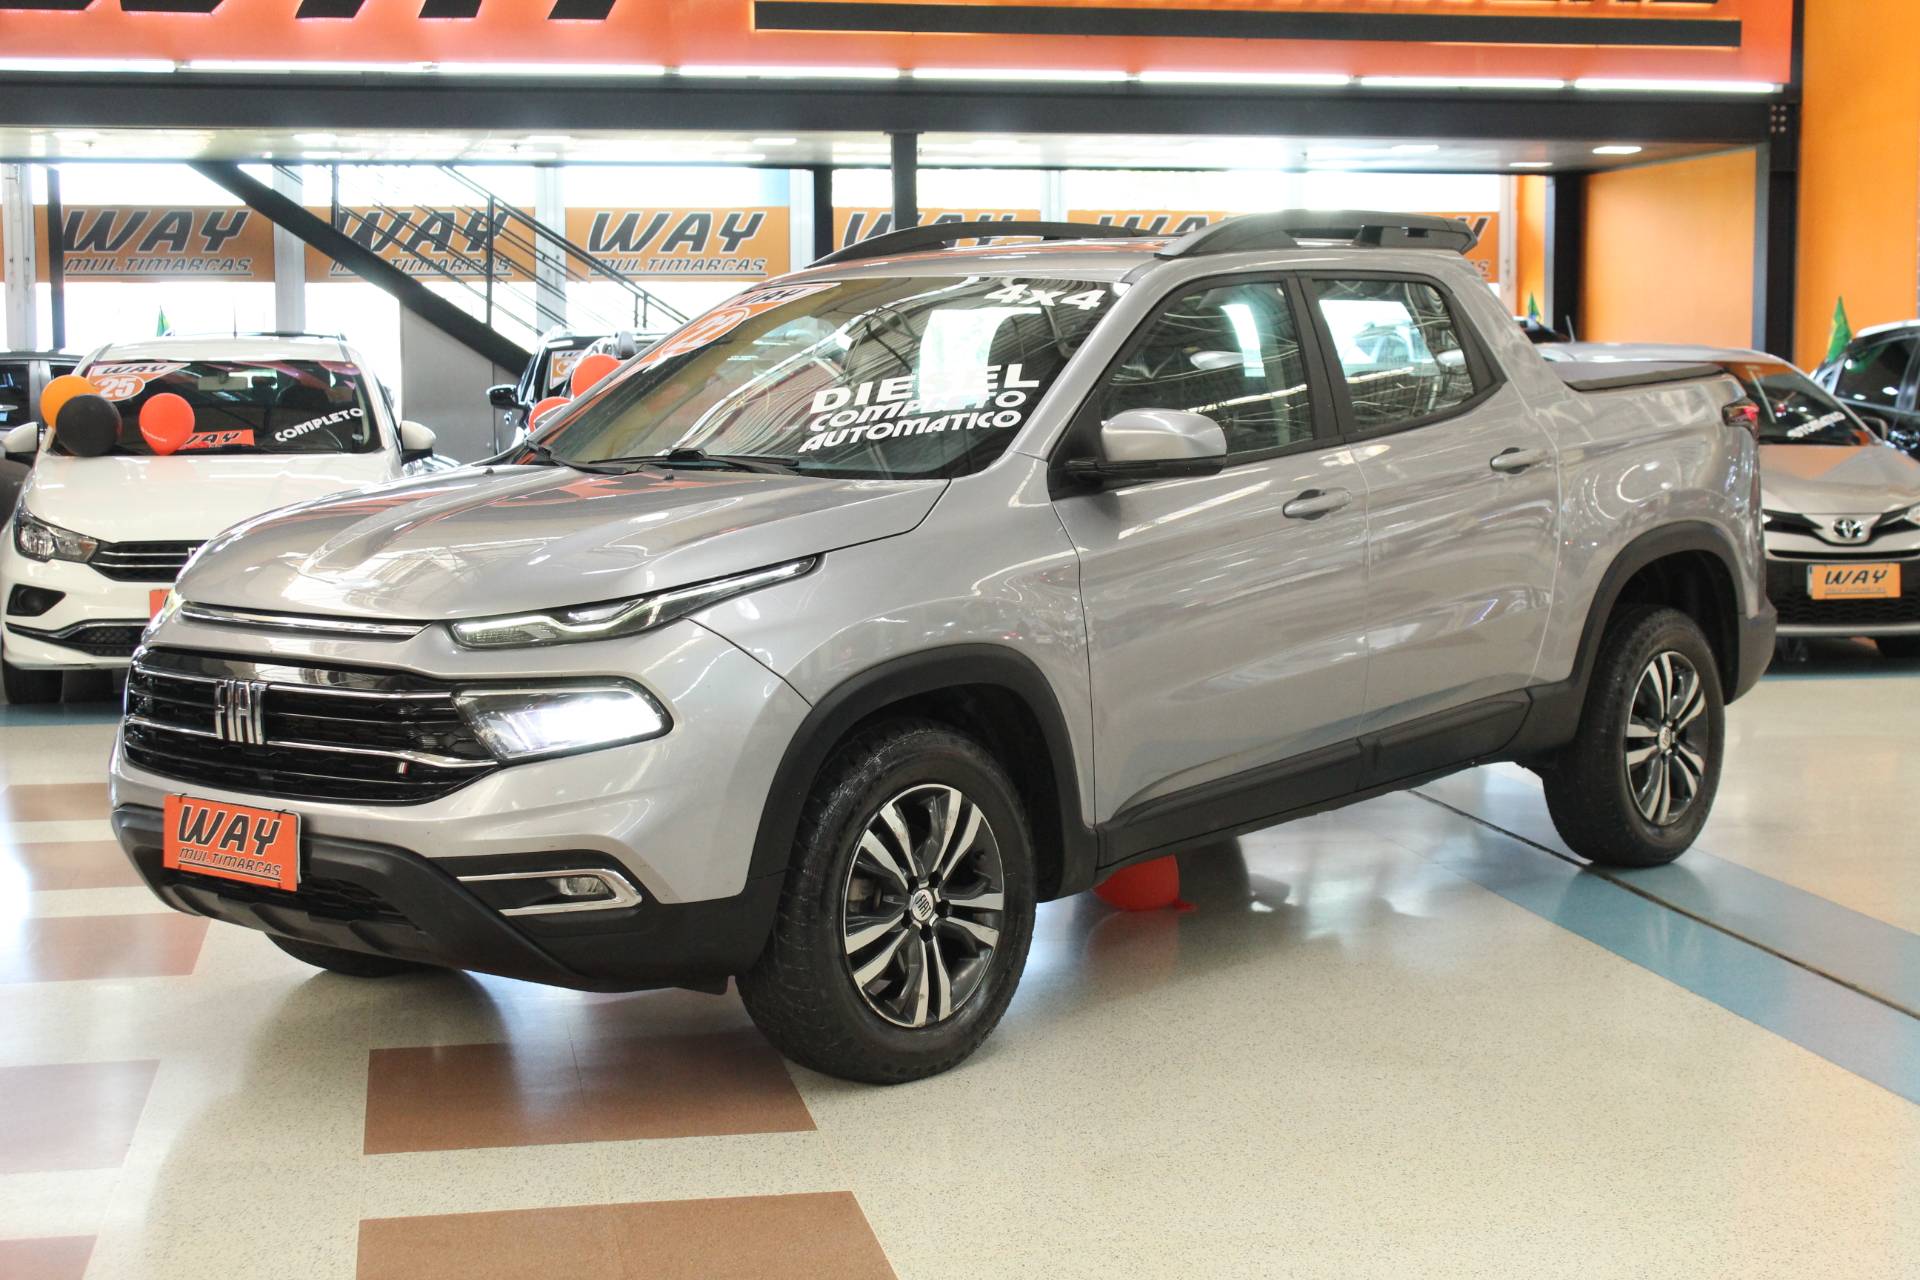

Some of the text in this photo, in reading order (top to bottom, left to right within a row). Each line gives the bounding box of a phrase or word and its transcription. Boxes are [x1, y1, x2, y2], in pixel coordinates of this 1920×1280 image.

[64, 209, 251, 253] WAY
[587, 211, 768, 254] WAY
[64, 257, 251, 272] MULTIMARCAS
[100, 378, 137, 397] 25
[810, 364, 1039, 414] DIEL
[274, 407, 364, 442] COMPLETO
[798, 410, 1022, 453] AUTOMATICO
[1825, 569, 1888, 585] WAY
[214, 680, 269, 745] FIAT
[178, 804, 284, 857] WAY
[178, 847, 282, 877] MULTIMARCAS
[915, 894, 932, 918] FIAT
